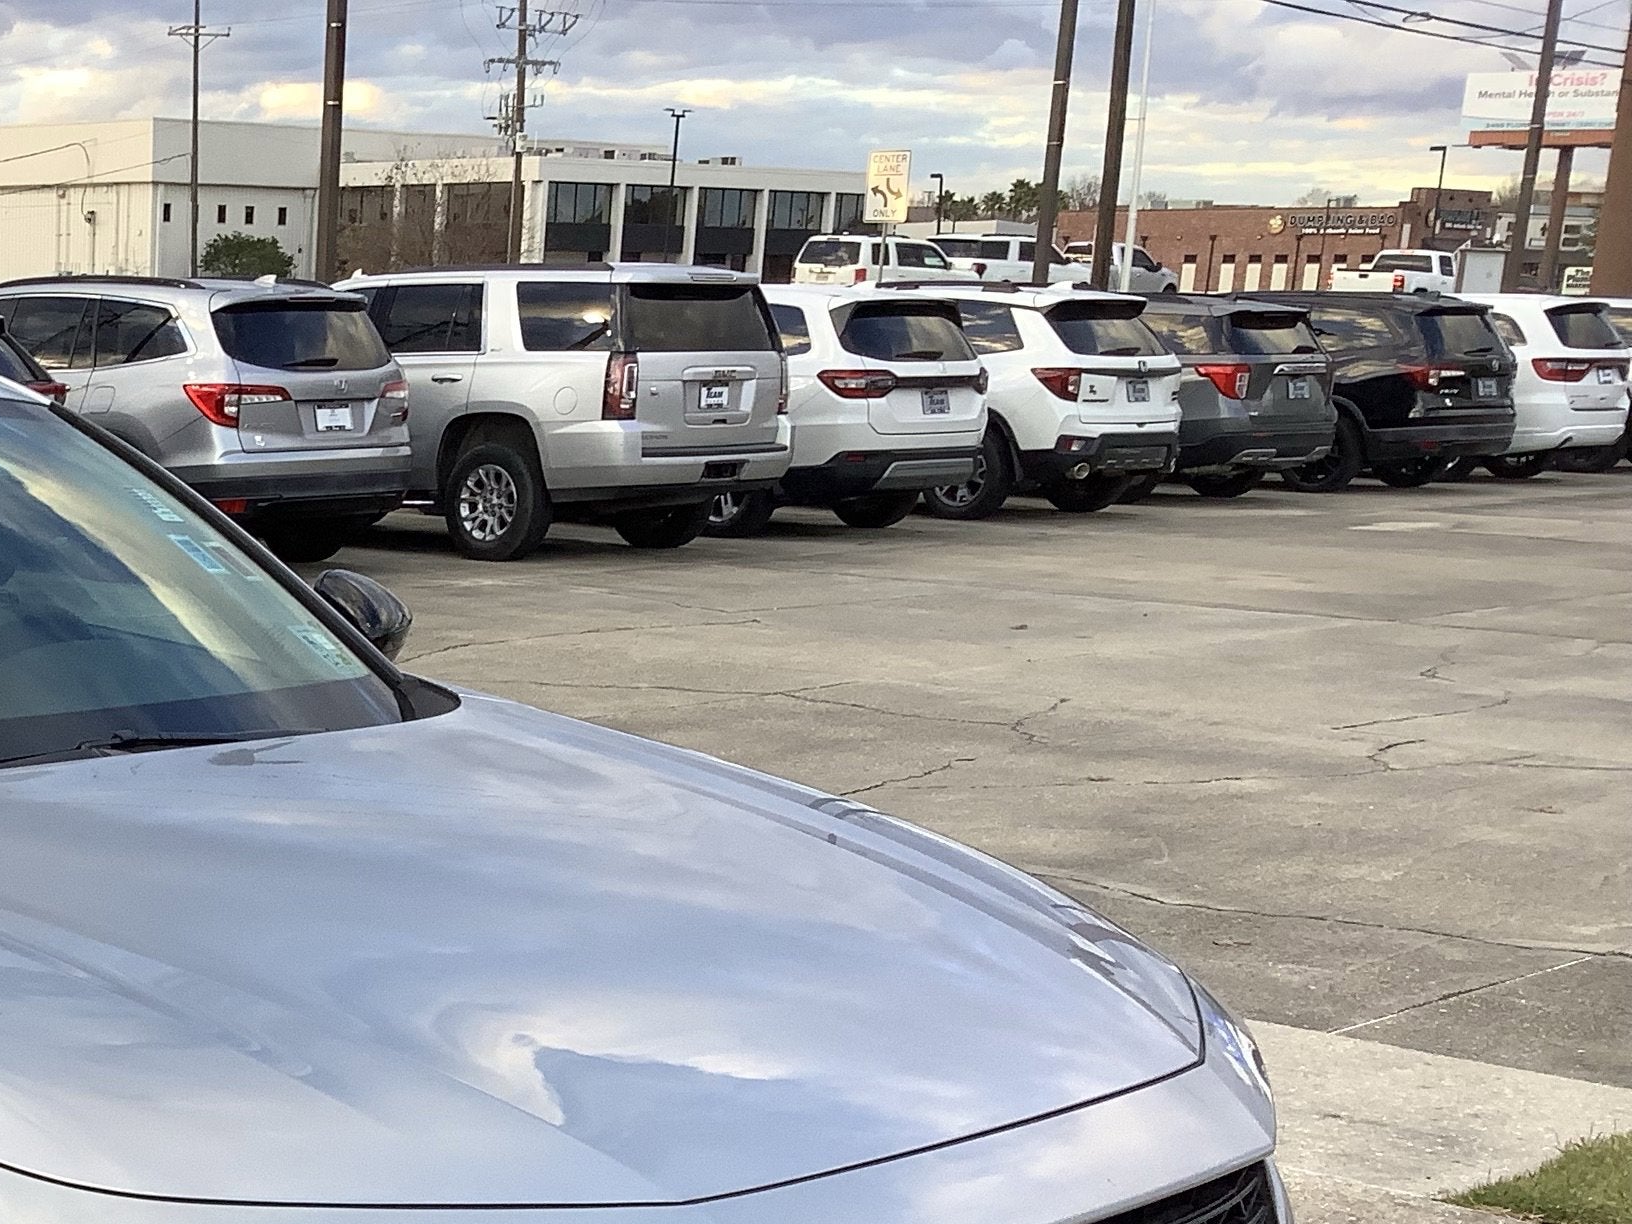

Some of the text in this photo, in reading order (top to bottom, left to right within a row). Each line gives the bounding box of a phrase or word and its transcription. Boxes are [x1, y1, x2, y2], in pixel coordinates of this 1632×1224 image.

[1550, 72, 1608, 87] Crisis?
[1477, 89, 1516, 99] Mental
[1558, 90, 1571, 98] or
[873, 154, 908, 163] CENTER
[878, 165, 901, 173] LANE
[873, 209, 896, 217] ONLY
[1369, 214, 1396, 227] BAO
